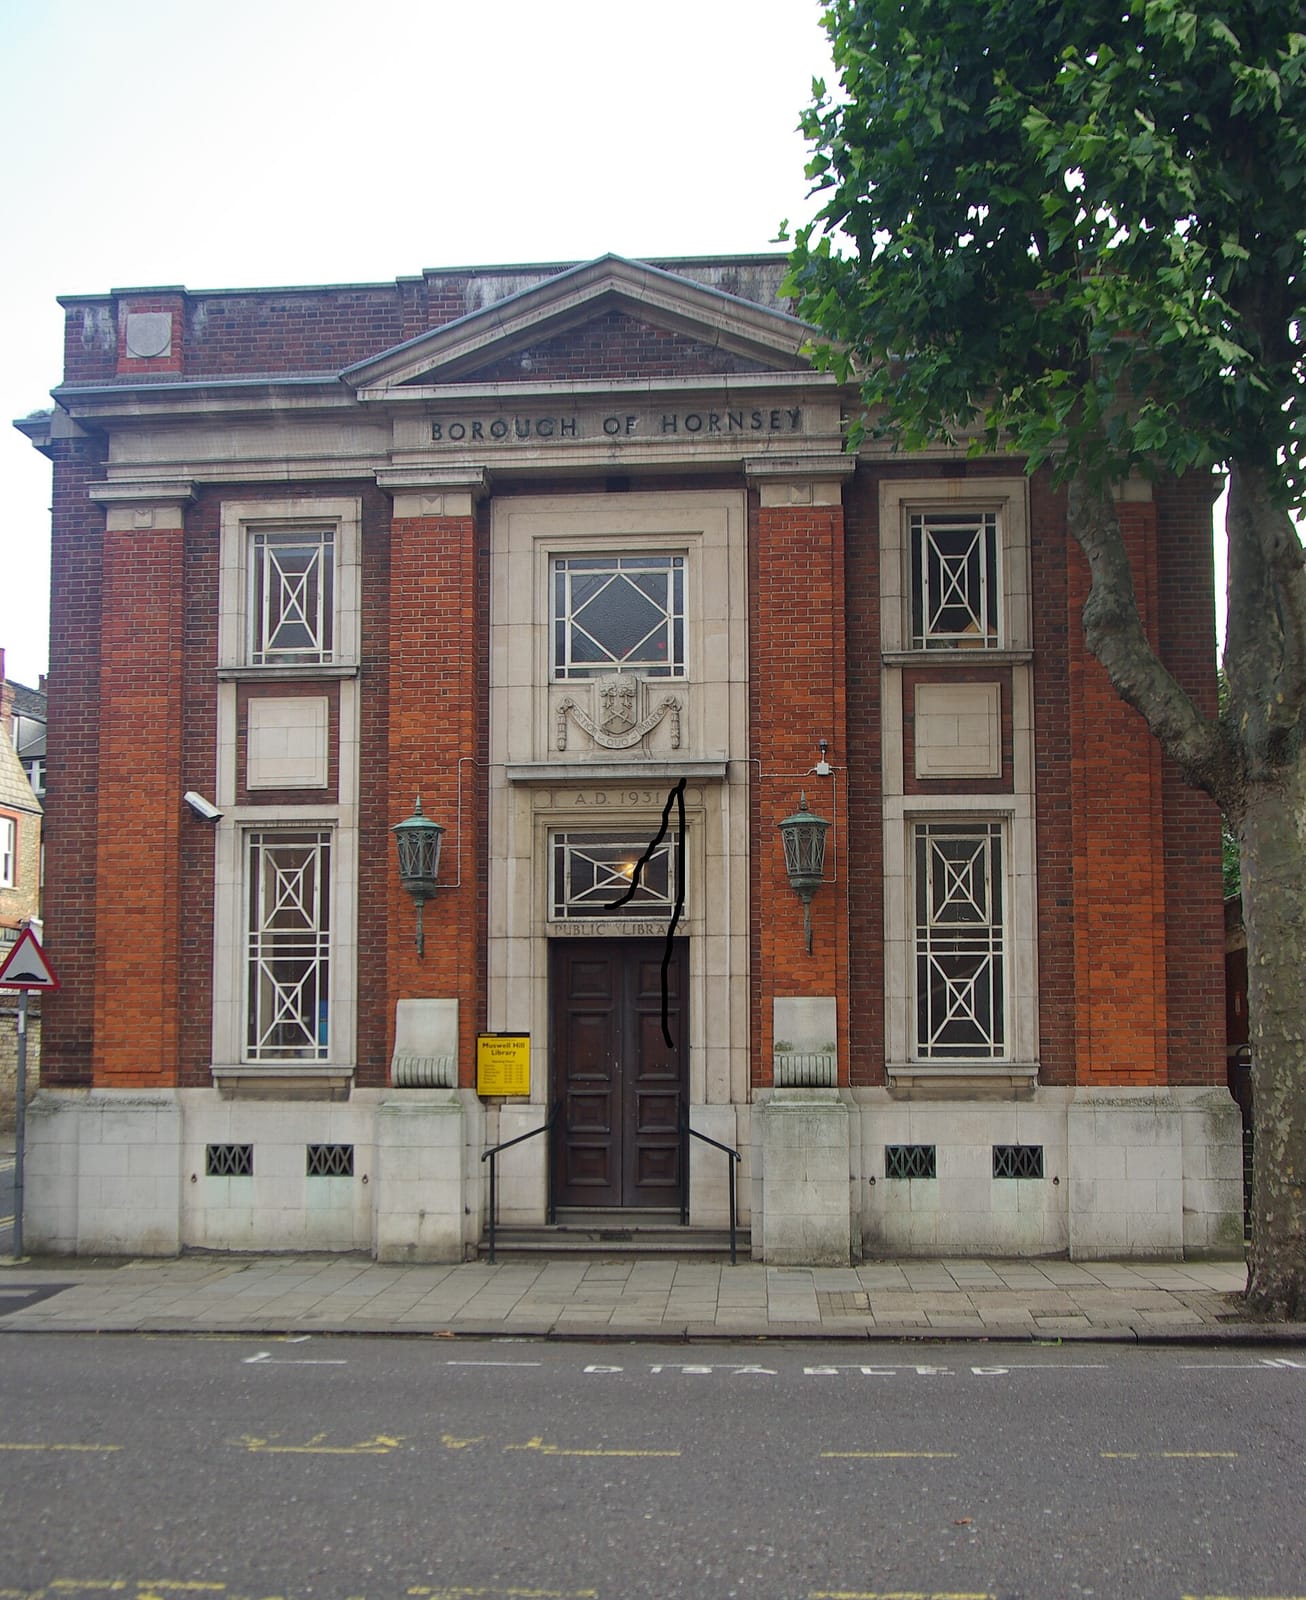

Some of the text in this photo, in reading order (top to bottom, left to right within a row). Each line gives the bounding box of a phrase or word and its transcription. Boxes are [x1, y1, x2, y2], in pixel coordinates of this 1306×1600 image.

[431, 407, 802, 441] BOROUGH OF HORNSEY
[620, 791, 660, 806] 1931
[554, 923, 687, 936] PUBLIC LIBRAY
[491, 1049, 517, 1057] Library
[583, 1364, 1010, 1376] DISABLED
